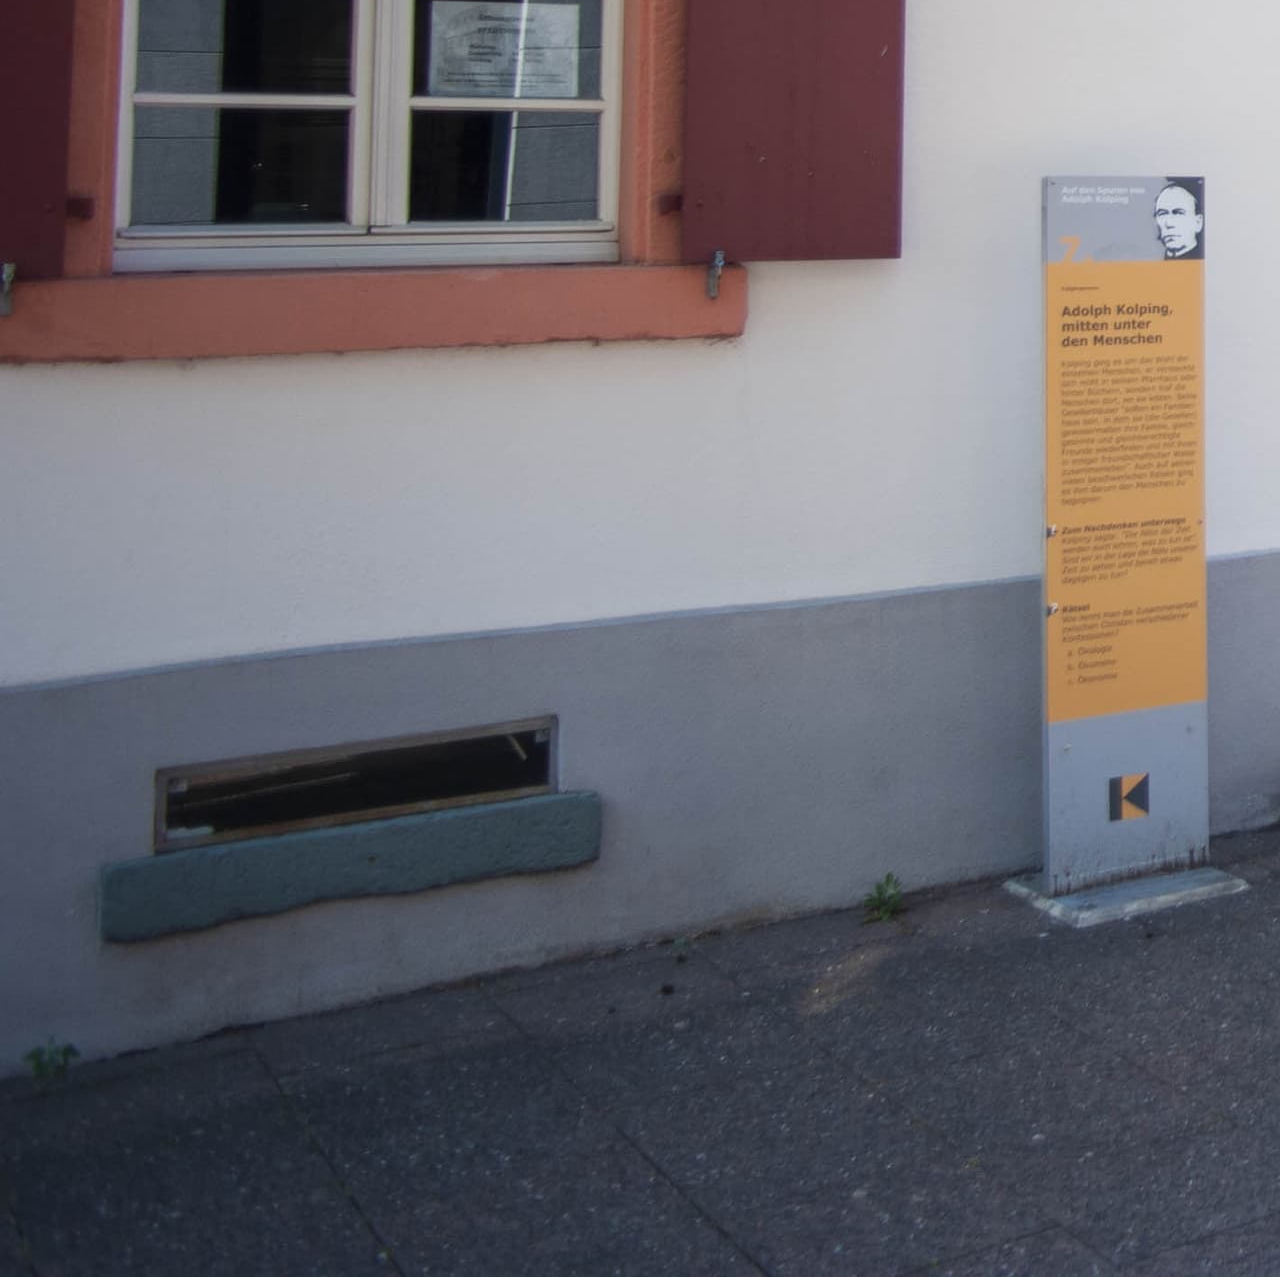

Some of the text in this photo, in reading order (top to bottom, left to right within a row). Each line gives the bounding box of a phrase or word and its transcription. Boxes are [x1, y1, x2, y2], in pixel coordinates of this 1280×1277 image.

[1061, 303, 1174, 319] Adolph Kolping,
[1061, 319, 1153, 332] mitten unter
[1061, 333, 1163, 347] den Menschen
[1083, 521, 1139, 533] Nachdenken
